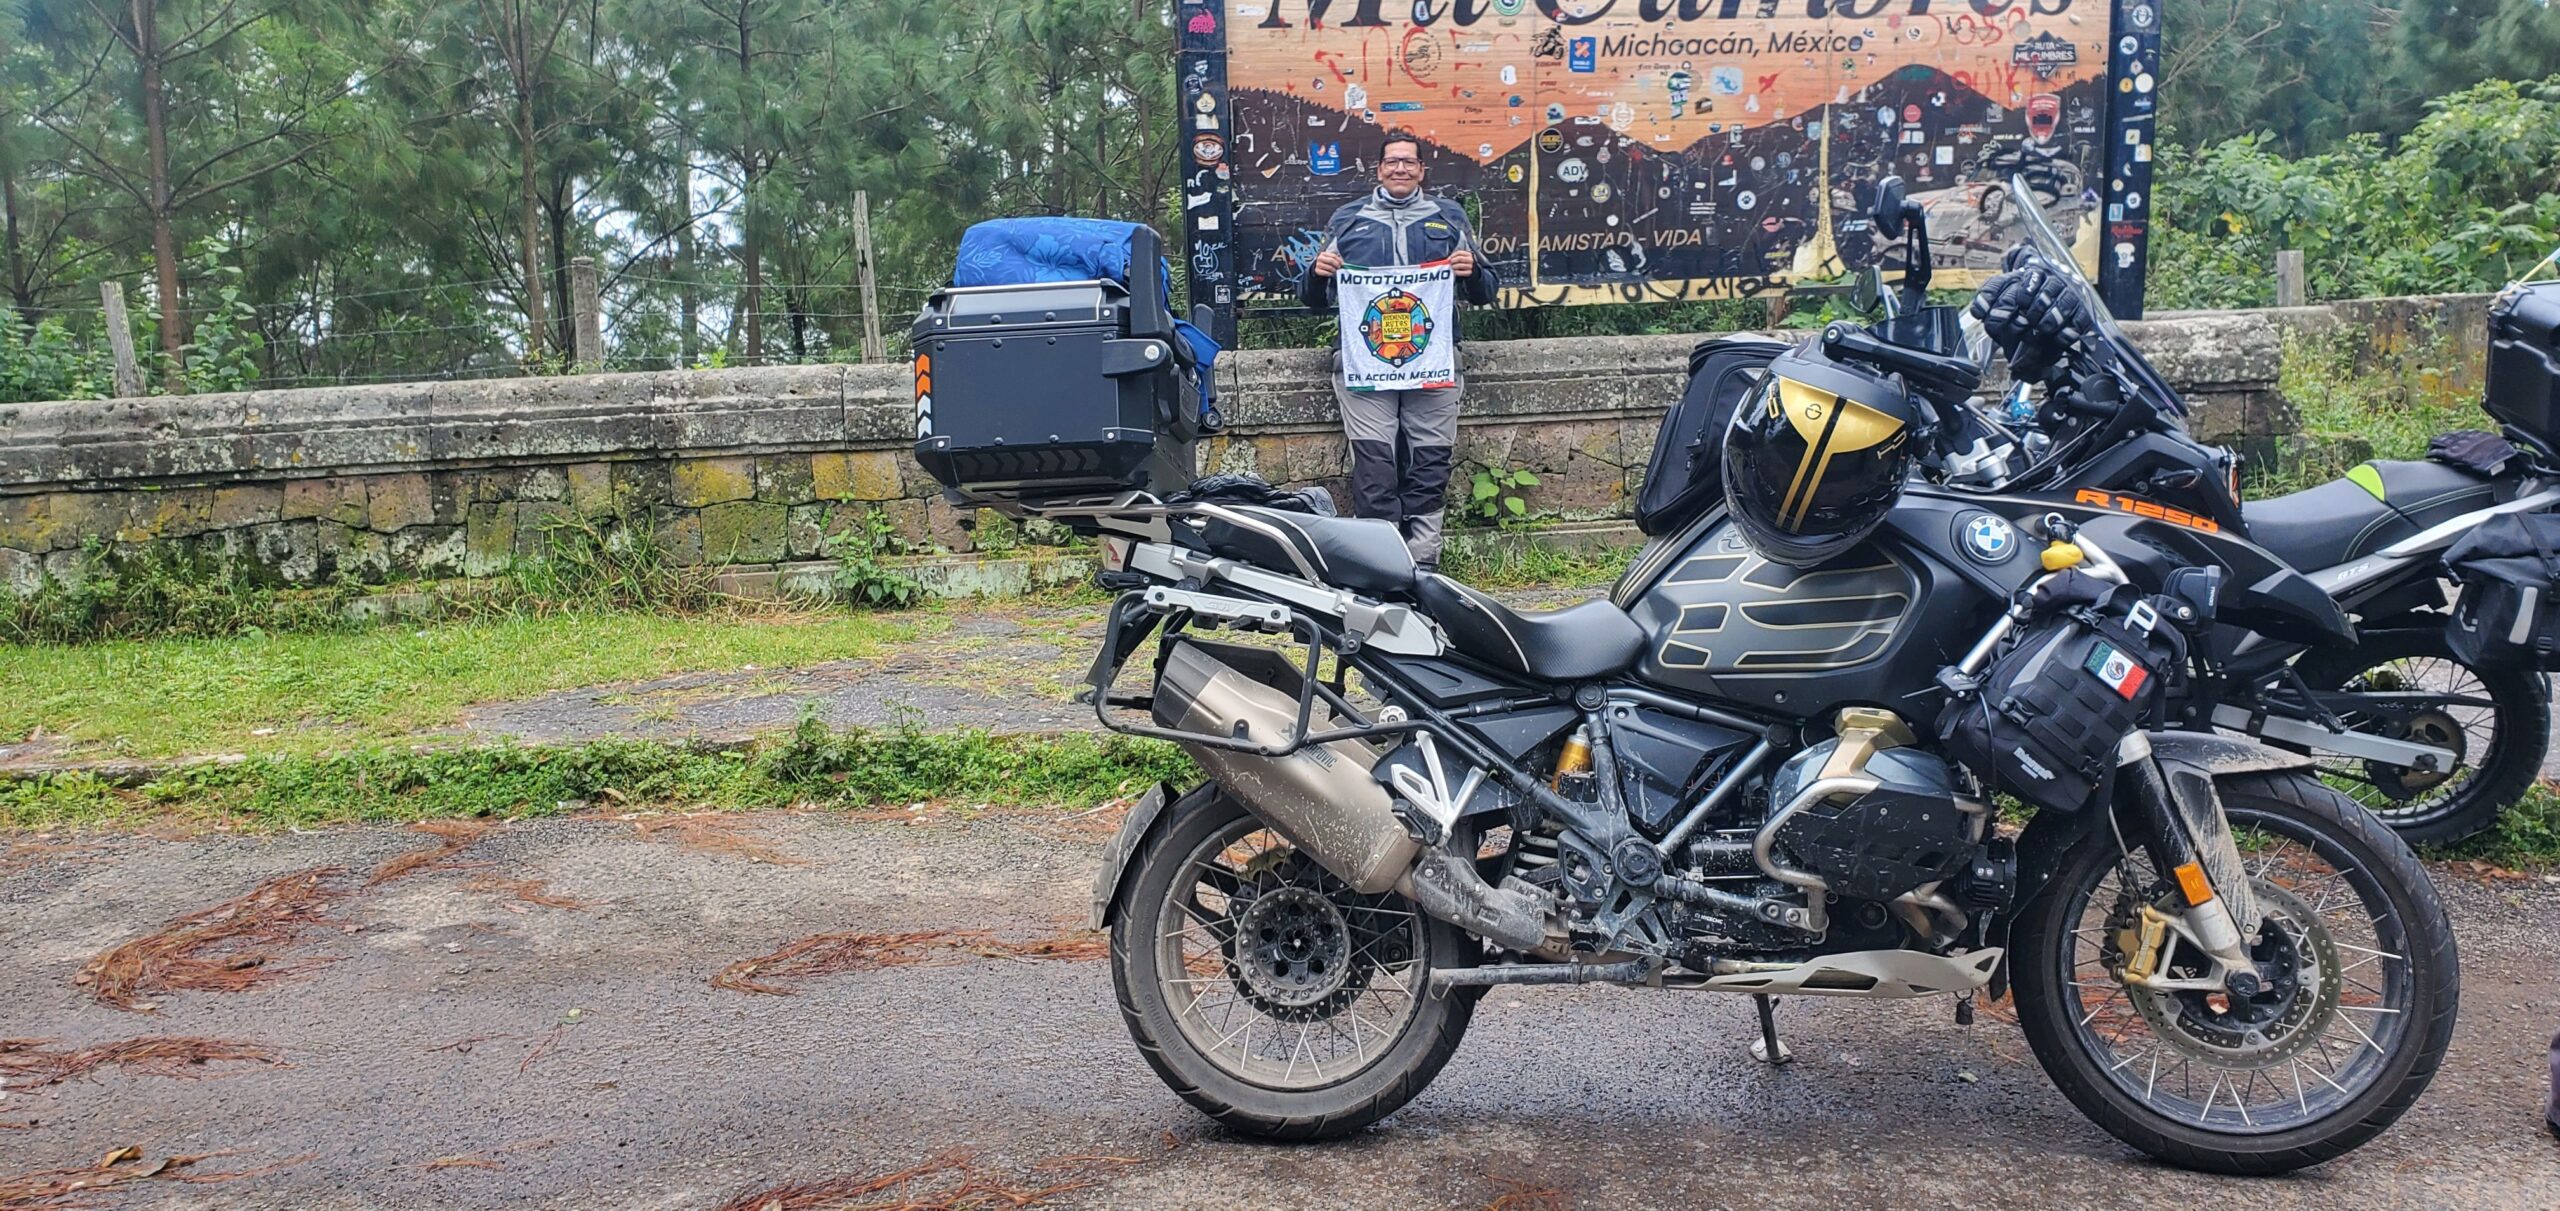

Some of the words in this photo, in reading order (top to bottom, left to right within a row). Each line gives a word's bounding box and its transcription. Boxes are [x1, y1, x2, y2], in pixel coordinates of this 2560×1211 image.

[1601, 32, 1760, 58] Michoacán,
[1767, 29, 1863, 53] México
[2015, 51, 2030, 61] MIL
[1562, 166, 1587, 176] ADV
[1537, 231, 1634, 252] AMISTAD
[1653, 229, 1701, 248] VIDA
[1340, 270, 1451, 285] MOTOTURISMO
[1348, 373, 1361, 381] EN
[1365, 370, 1406, 381] ACCIÓN
[1409, 368, 1451, 380] MÉXICO
[2074, 489, 2111, 508] R
[2115, 496, 2219, 534] 1250
[1971, 517, 2011, 534] BMW
